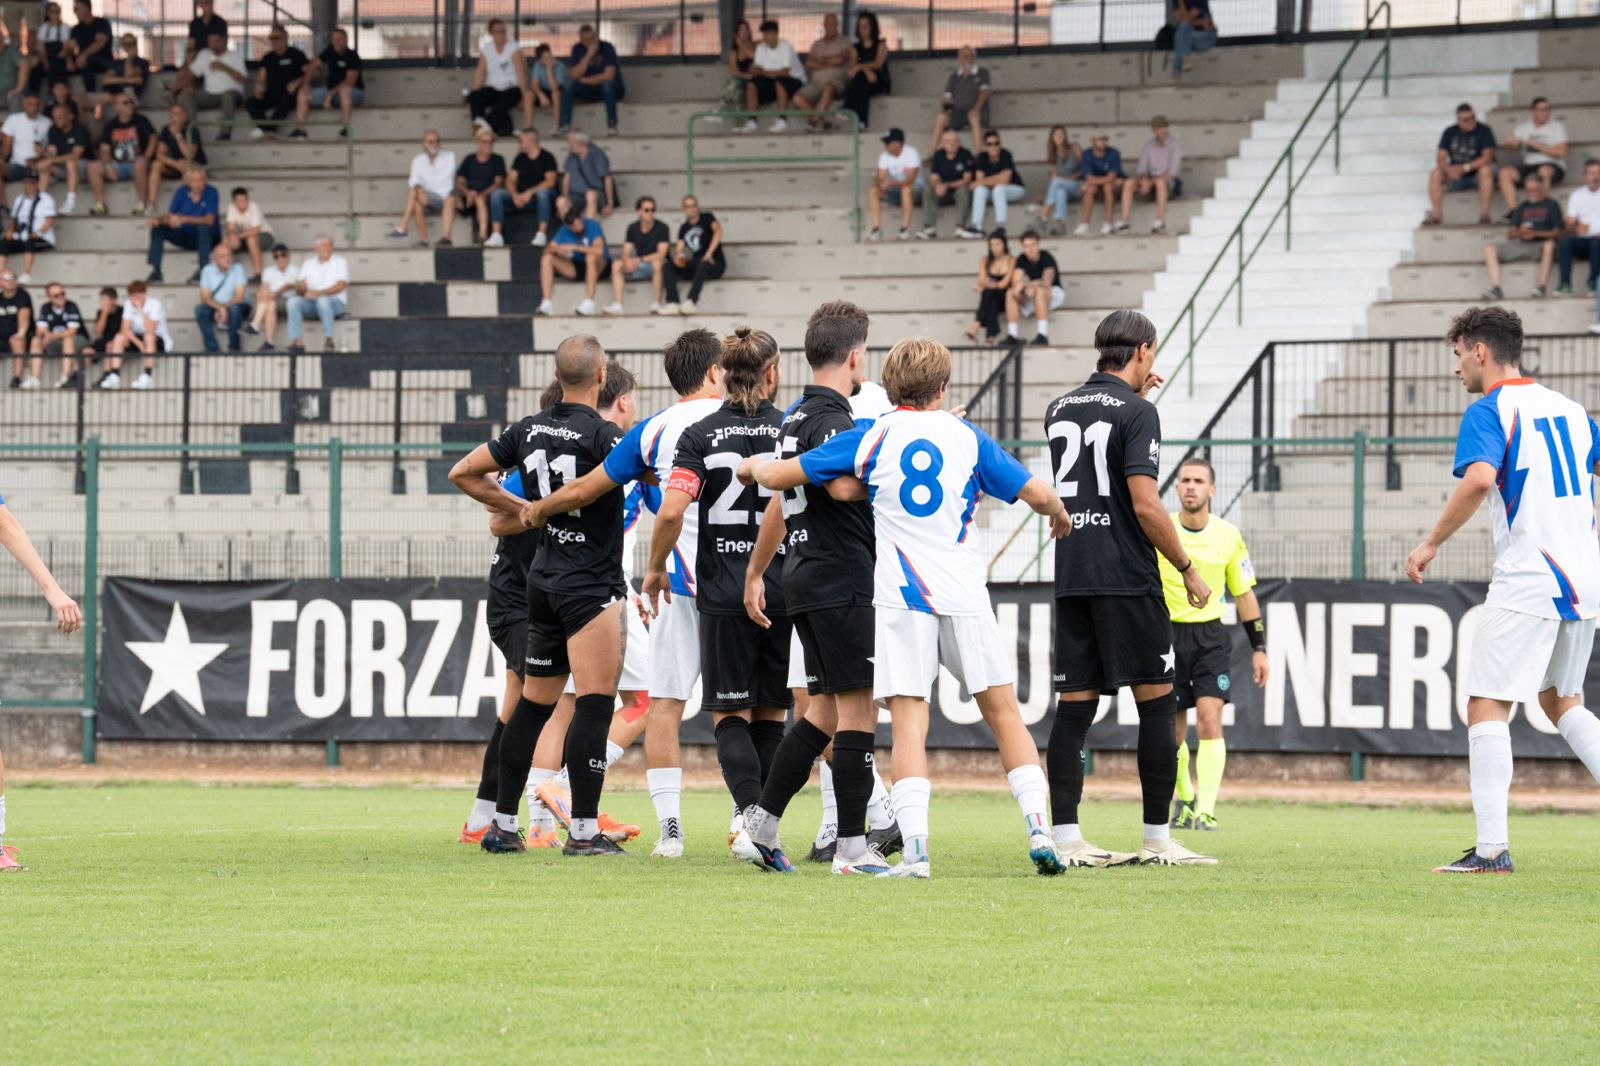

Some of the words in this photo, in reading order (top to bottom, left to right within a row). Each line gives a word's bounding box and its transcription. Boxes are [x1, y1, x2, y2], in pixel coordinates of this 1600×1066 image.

[723, 424, 781, 439] pastorfrig
[1063, 392, 1126, 408] pastorfrigor
[523, 449, 581, 518] 11
[899, 438, 944, 518] 8
[1047, 420, 1113, 498] 21
[1532, 415, 1582, 498] 11
[246, 598, 508, 719] FORZA
